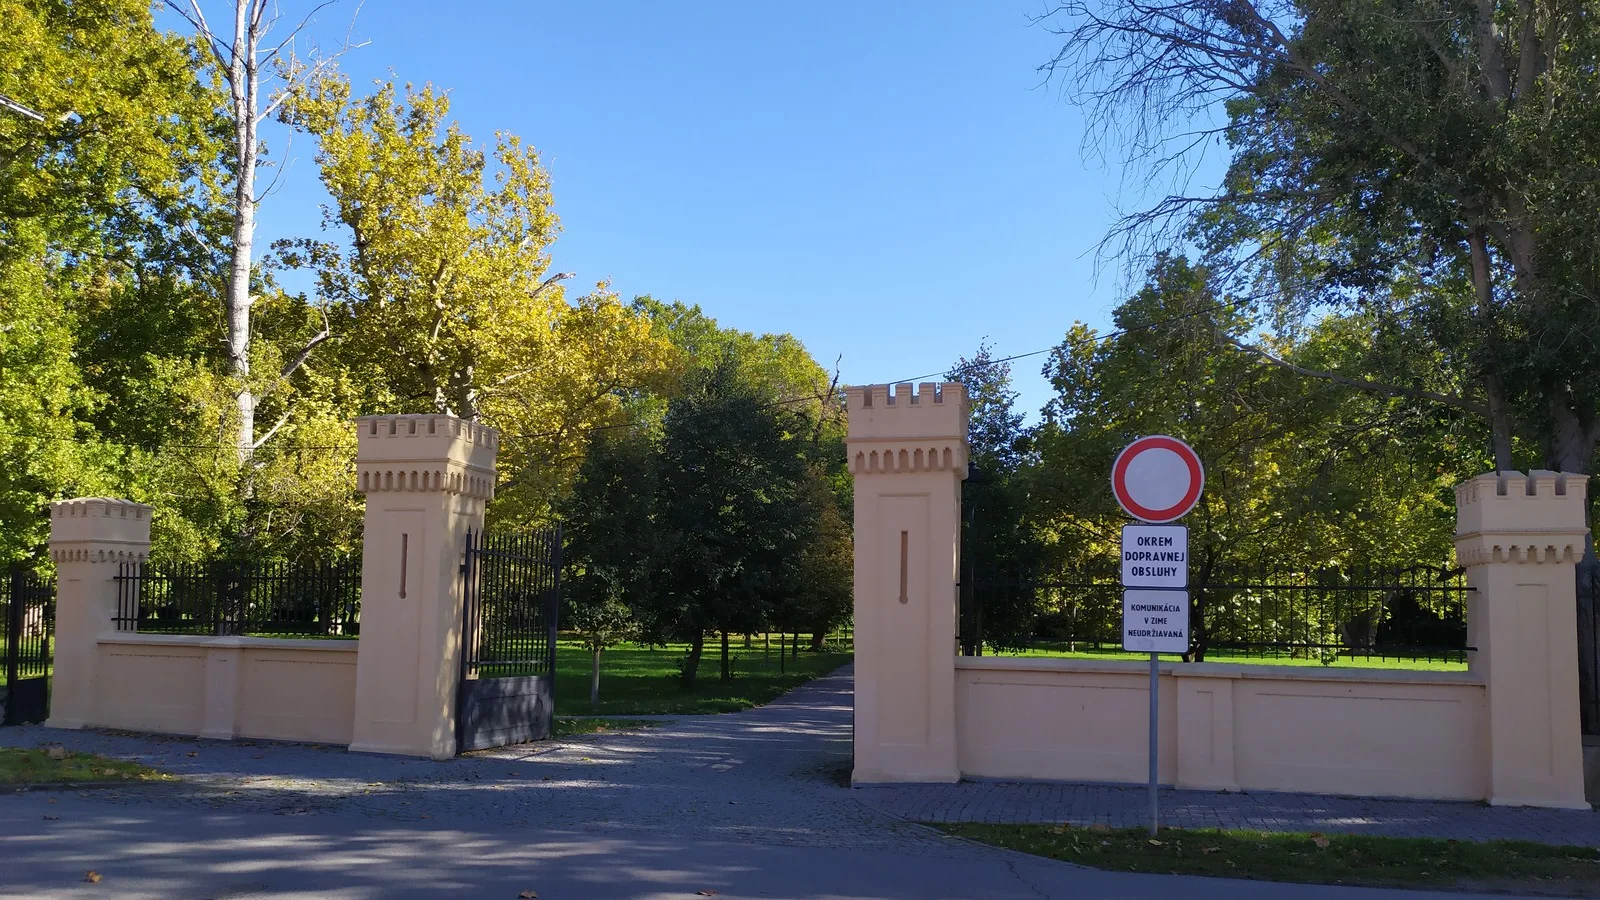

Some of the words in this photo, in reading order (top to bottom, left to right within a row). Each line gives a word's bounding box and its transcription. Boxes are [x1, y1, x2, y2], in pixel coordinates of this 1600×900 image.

[1137, 536, 1173, 547] OKREM
[1125, 551, 1185, 562] DOPRAVNEJ
[1131, 566, 1177, 577] OBSLUHY
[1131, 603, 1180, 612] KOMUNIKÁCIA
[1144, 617, 1149, 625] V
[1151, 617, 1168, 625] ZIME
[1128, 628, 1183, 638] NEUDRŽIAVANÁ
